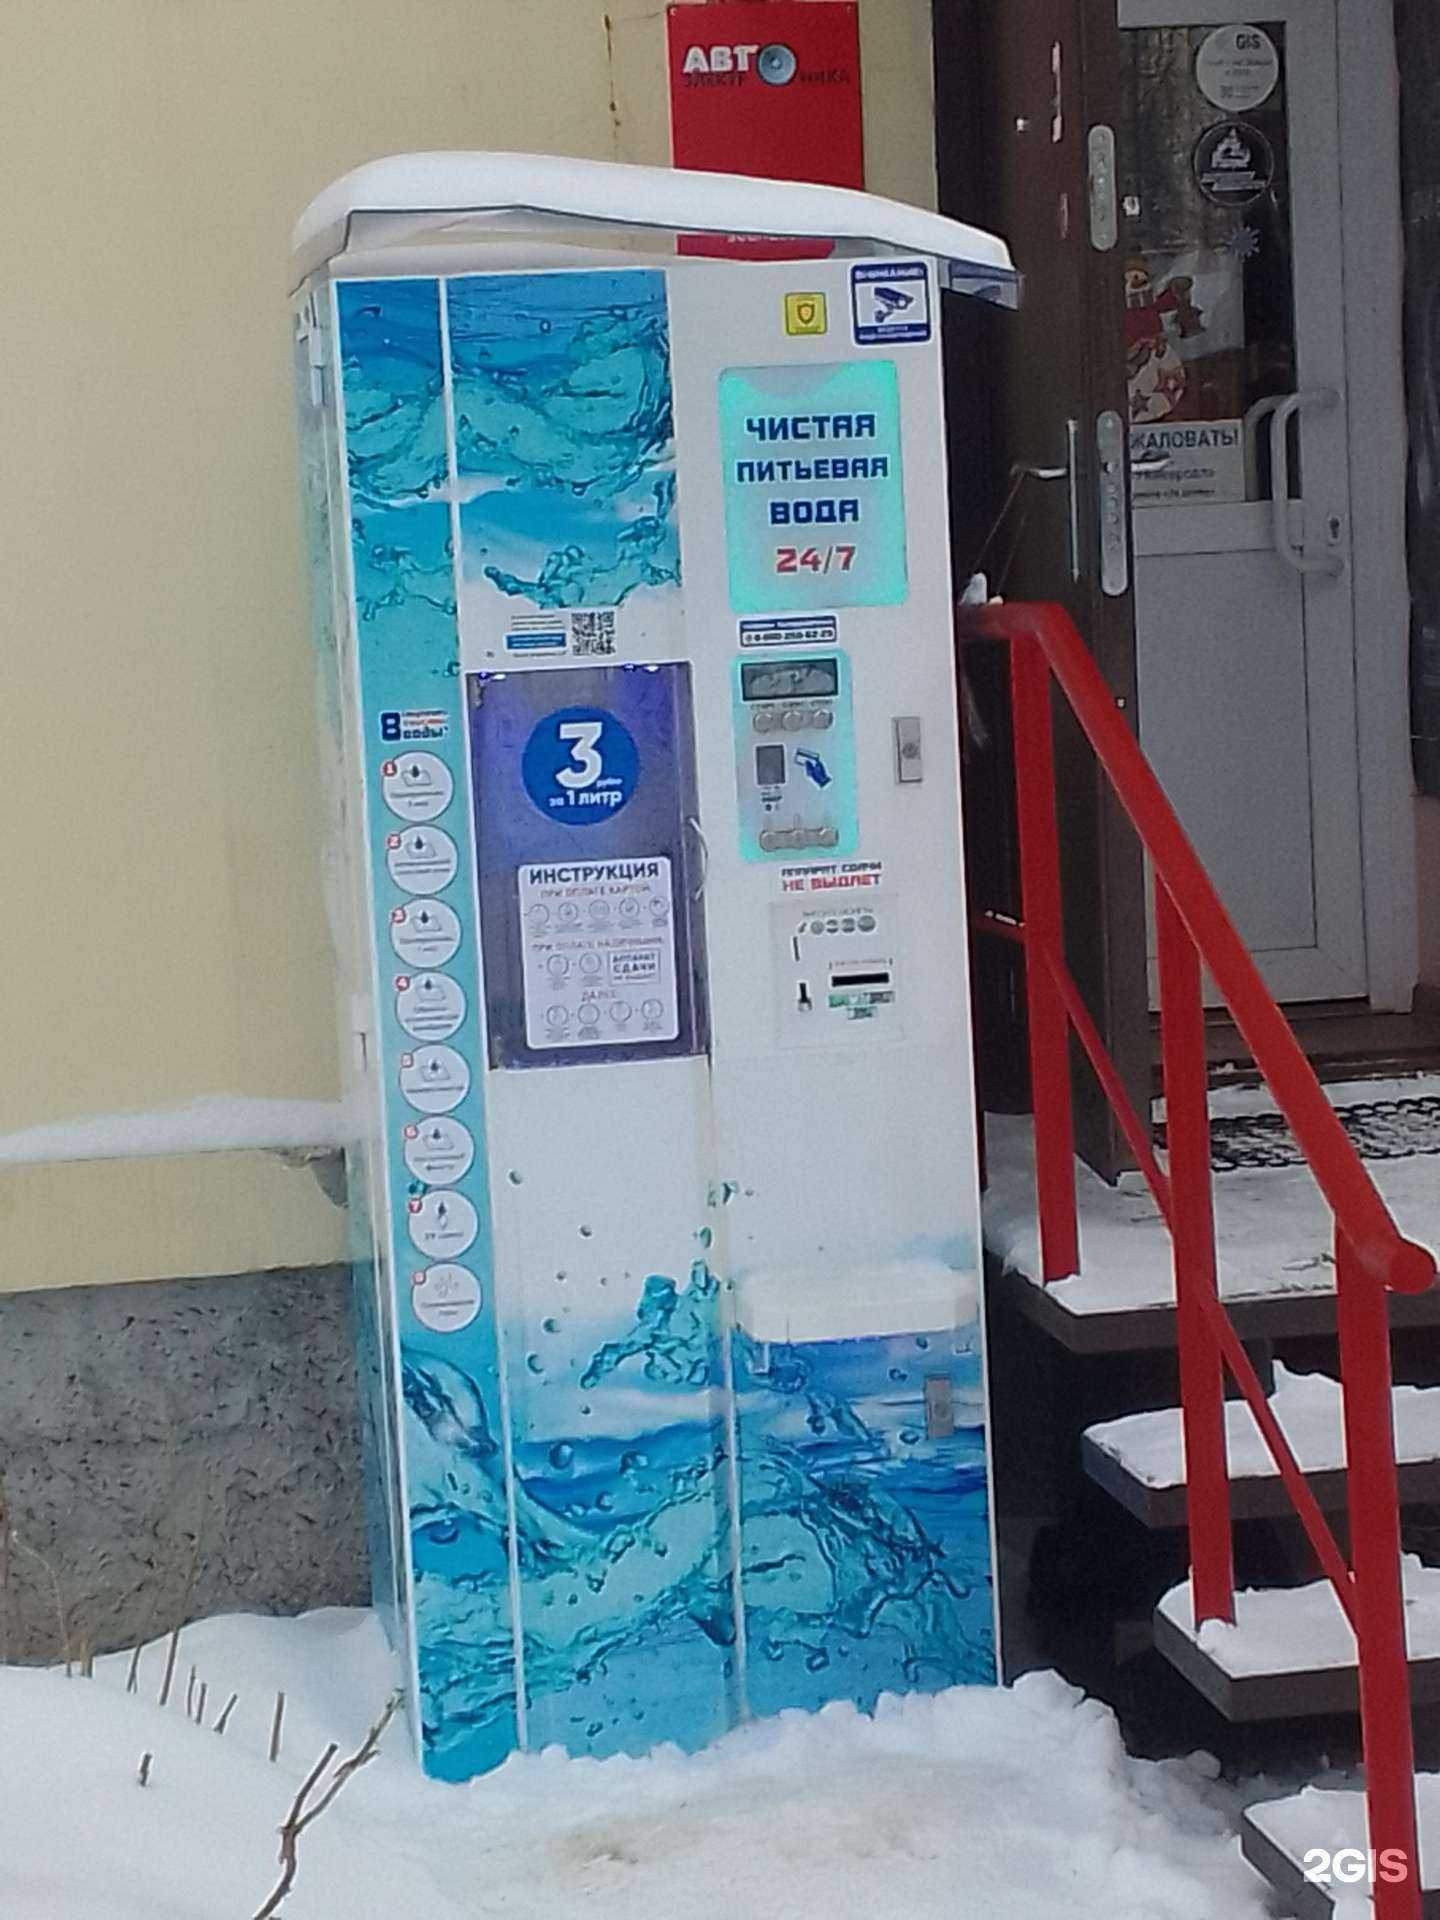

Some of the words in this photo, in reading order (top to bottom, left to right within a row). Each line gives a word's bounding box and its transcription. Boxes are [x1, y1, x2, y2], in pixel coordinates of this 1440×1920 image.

[746, 414, 876, 442] ЧИСТАЯ
[736, 456, 889, 483] ПИТЬЕВАЯ
[770, 498, 860, 525] ВОДА
[775, 545, 857, 575] 24/7
[556, 721, 602, 789] 3
[566, 789, 576, 806] 1
[578, 791, 622, 807] литр
[529, 862, 659, 885] ИНСТРУКЦИЯ
[782, 879, 804, 892] НЕ
